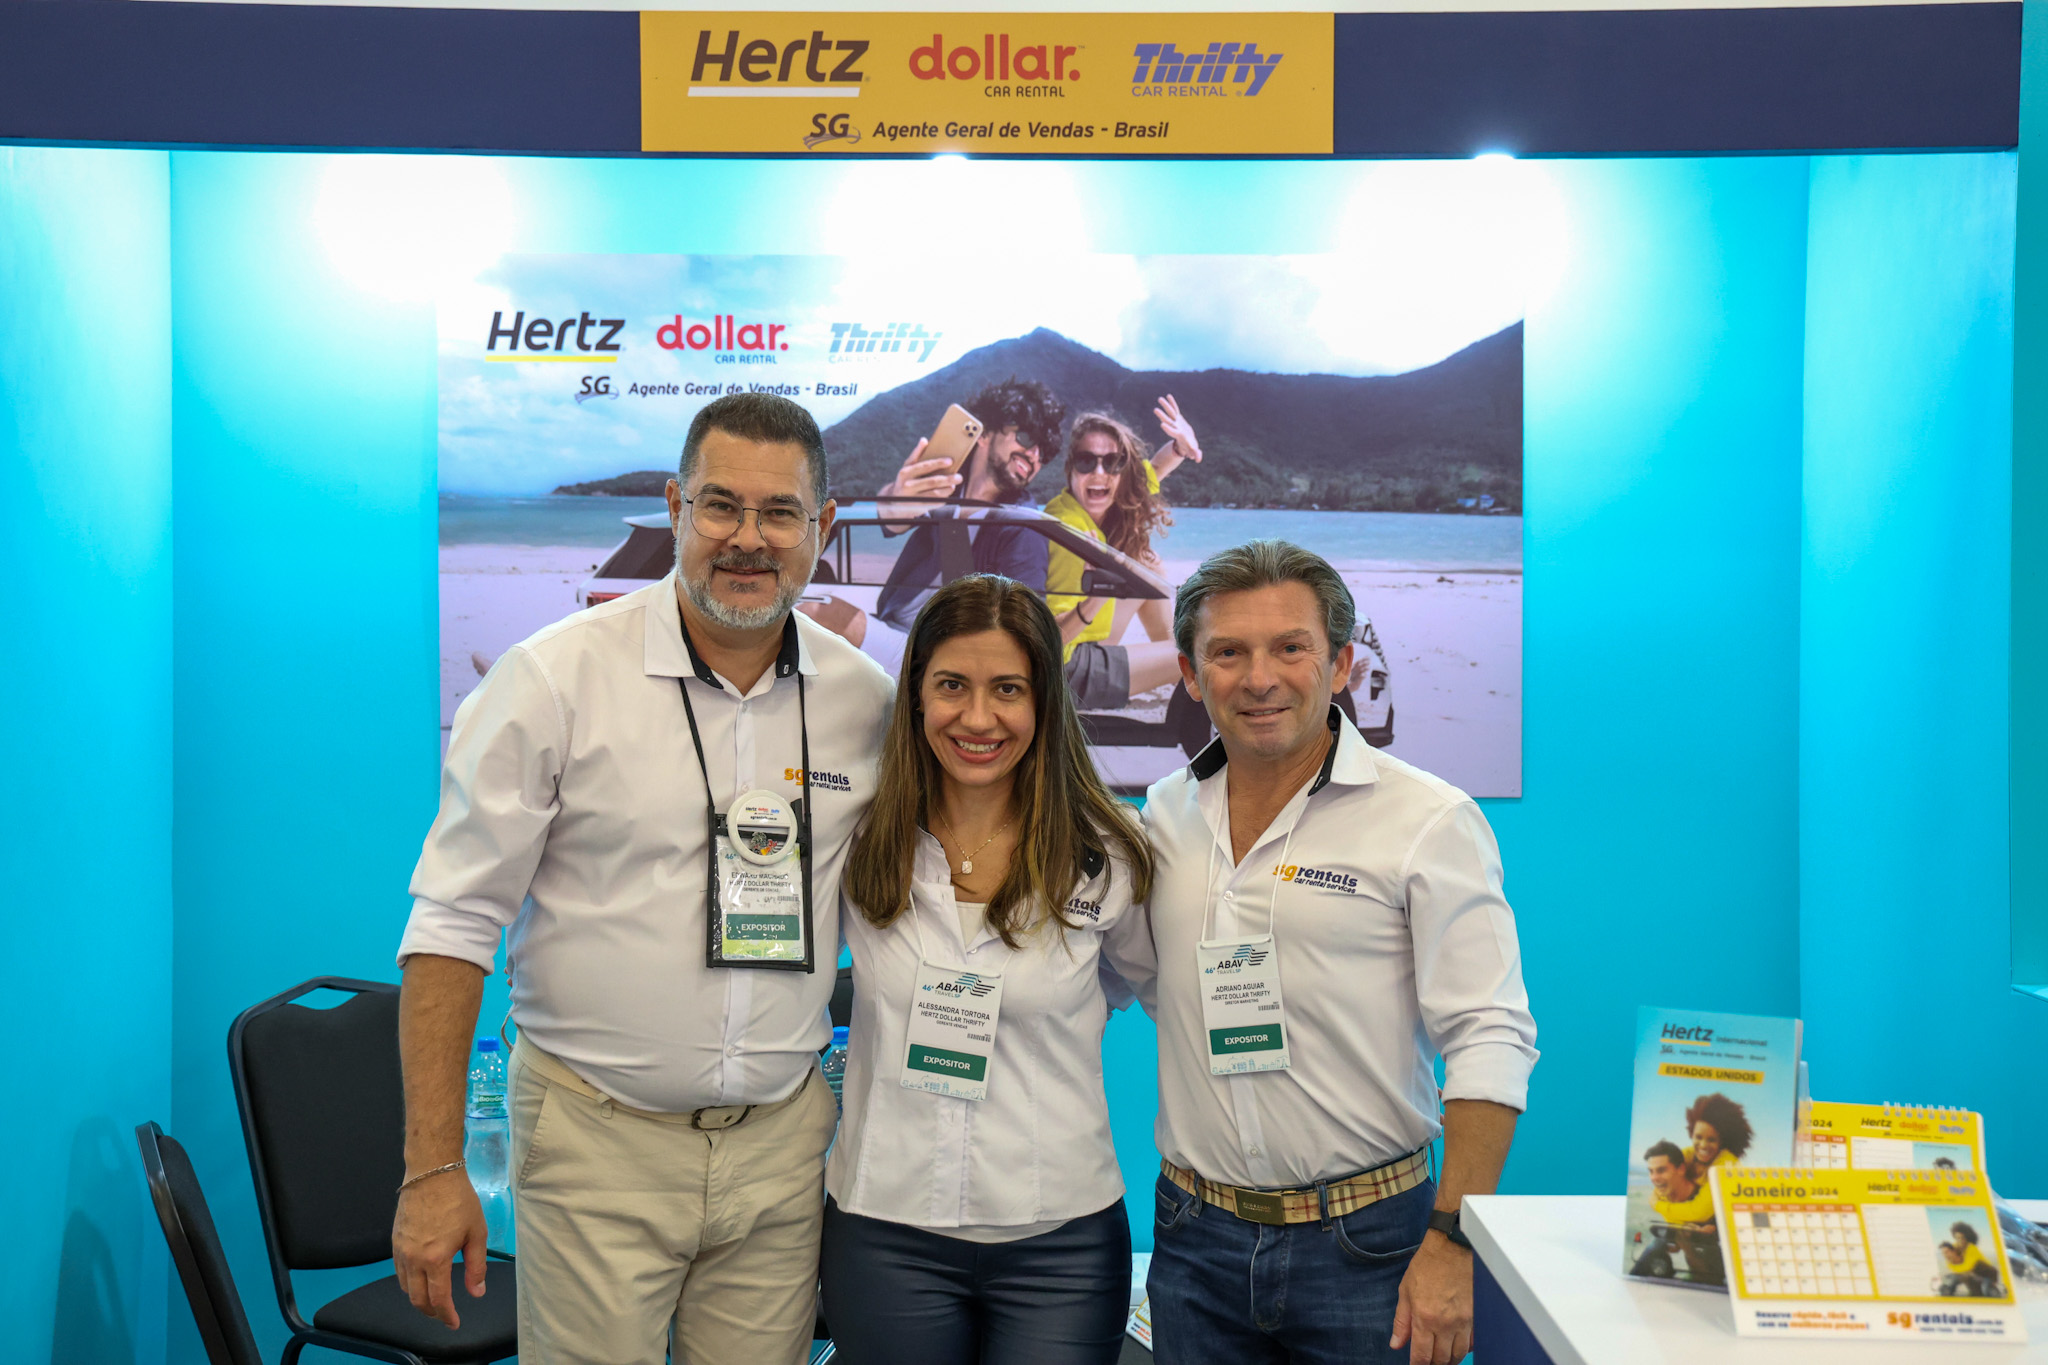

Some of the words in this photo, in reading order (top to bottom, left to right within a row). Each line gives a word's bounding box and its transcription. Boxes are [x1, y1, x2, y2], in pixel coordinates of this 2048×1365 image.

[689, 30, 869, 82] Hertz
[908, 33, 1081, 81] dollar.
[1132, 42, 1284, 96] Thrifty
[984, 85, 1011, 97] CAR
[1016, 85, 1065, 97] RENTAL
[1131, 86, 1163, 97] CAR
[1168, 86, 1228, 97] RENTAL
[810, 113, 850, 138] SG
[872, 121, 939, 141] Agente
[945, 121, 994, 138] Geral
[999, 121, 1021, 138] de
[1028, 121, 1095, 138] Vendas
[1115, 121, 1169, 138] Brasil
[487, 311, 626, 351] Hertz
[656, 314, 789, 351] dollar.
[829, 322, 943, 363] Thrifty
[714, 355, 736, 364] CAR
[739, 355, 777, 364] RENTAL
[579, 376, 611, 395] SG
[628, 383, 679, 397] Agente
[685, 383, 722, 395] Geral
[727, 383, 743, 394] de
[748, 383, 800, 395] Vendas
[815, 383, 857, 395] Brasil
[1294, 877, 1306, 885] car
[1306, 879, 1327, 889] rental
[1326, 883, 1357, 894] services
[741, 923, 786, 932] EXPOSITOR
[1217, 959, 1244, 970] ABAV
[936, 982, 966, 993] ABAV
[1216, 984, 1242, 993] ADRIANO
[1243, 982, 1265, 990] AGUIAR
[918, 1002, 960, 1015] ALESSANDRA
[961, 1009, 990, 1020] TORTORA
[921, 1010, 939, 1018] HERTZ
[940, 1013, 961, 1023] DOLLAR
[963, 1018, 985, 1027] THRIFTY
[1225, 1034, 1269, 1045] EXPOSITOR
[1661, 1023, 1713, 1041] Hertz
[923, 1055, 970, 1070] EXPOSITOR
[1665, 1065, 1712, 1078] ESTADOS
[1715, 1070, 1757, 1082] UNIDOS
[1861, 1118, 1892, 1128] Hertz
[1731, 1183, 1806, 1198] Janeiro
[1811, 1187, 1838, 1196] 2024
[1868, 1183, 1899, 1192] Hertz
